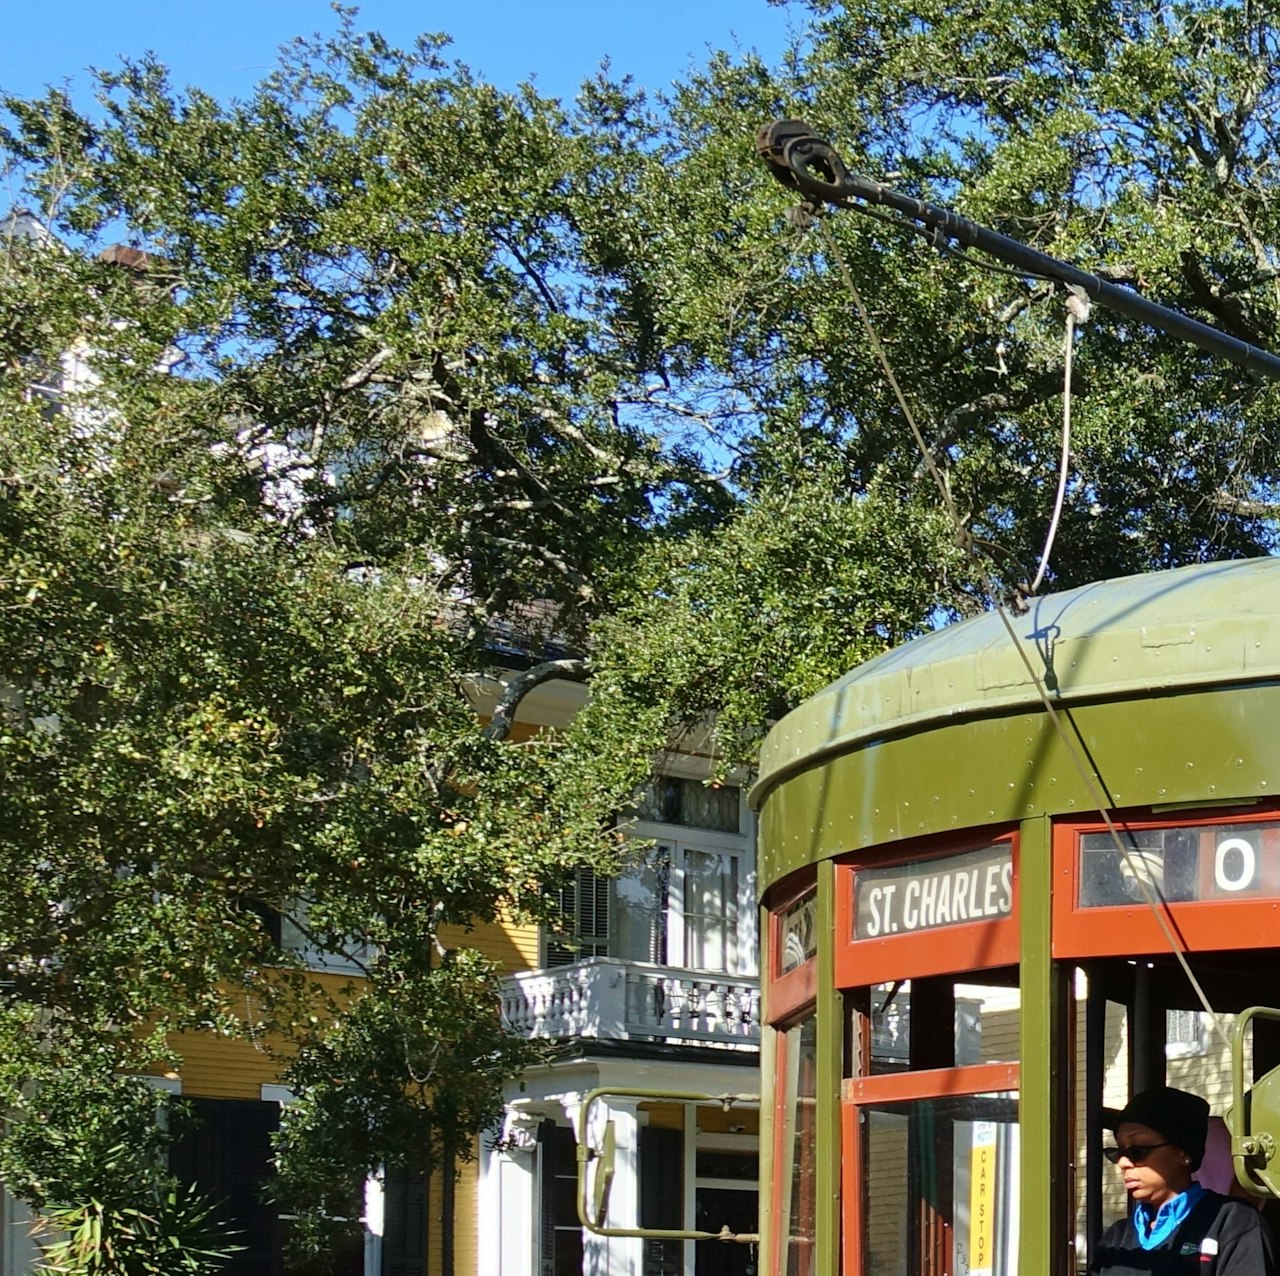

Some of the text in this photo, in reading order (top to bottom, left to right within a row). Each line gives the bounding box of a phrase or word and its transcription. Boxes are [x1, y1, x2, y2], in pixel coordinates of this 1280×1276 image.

[867, 862, 1013, 937] ST. CHARLES
[979, 1151, 987, 1196] CAR
